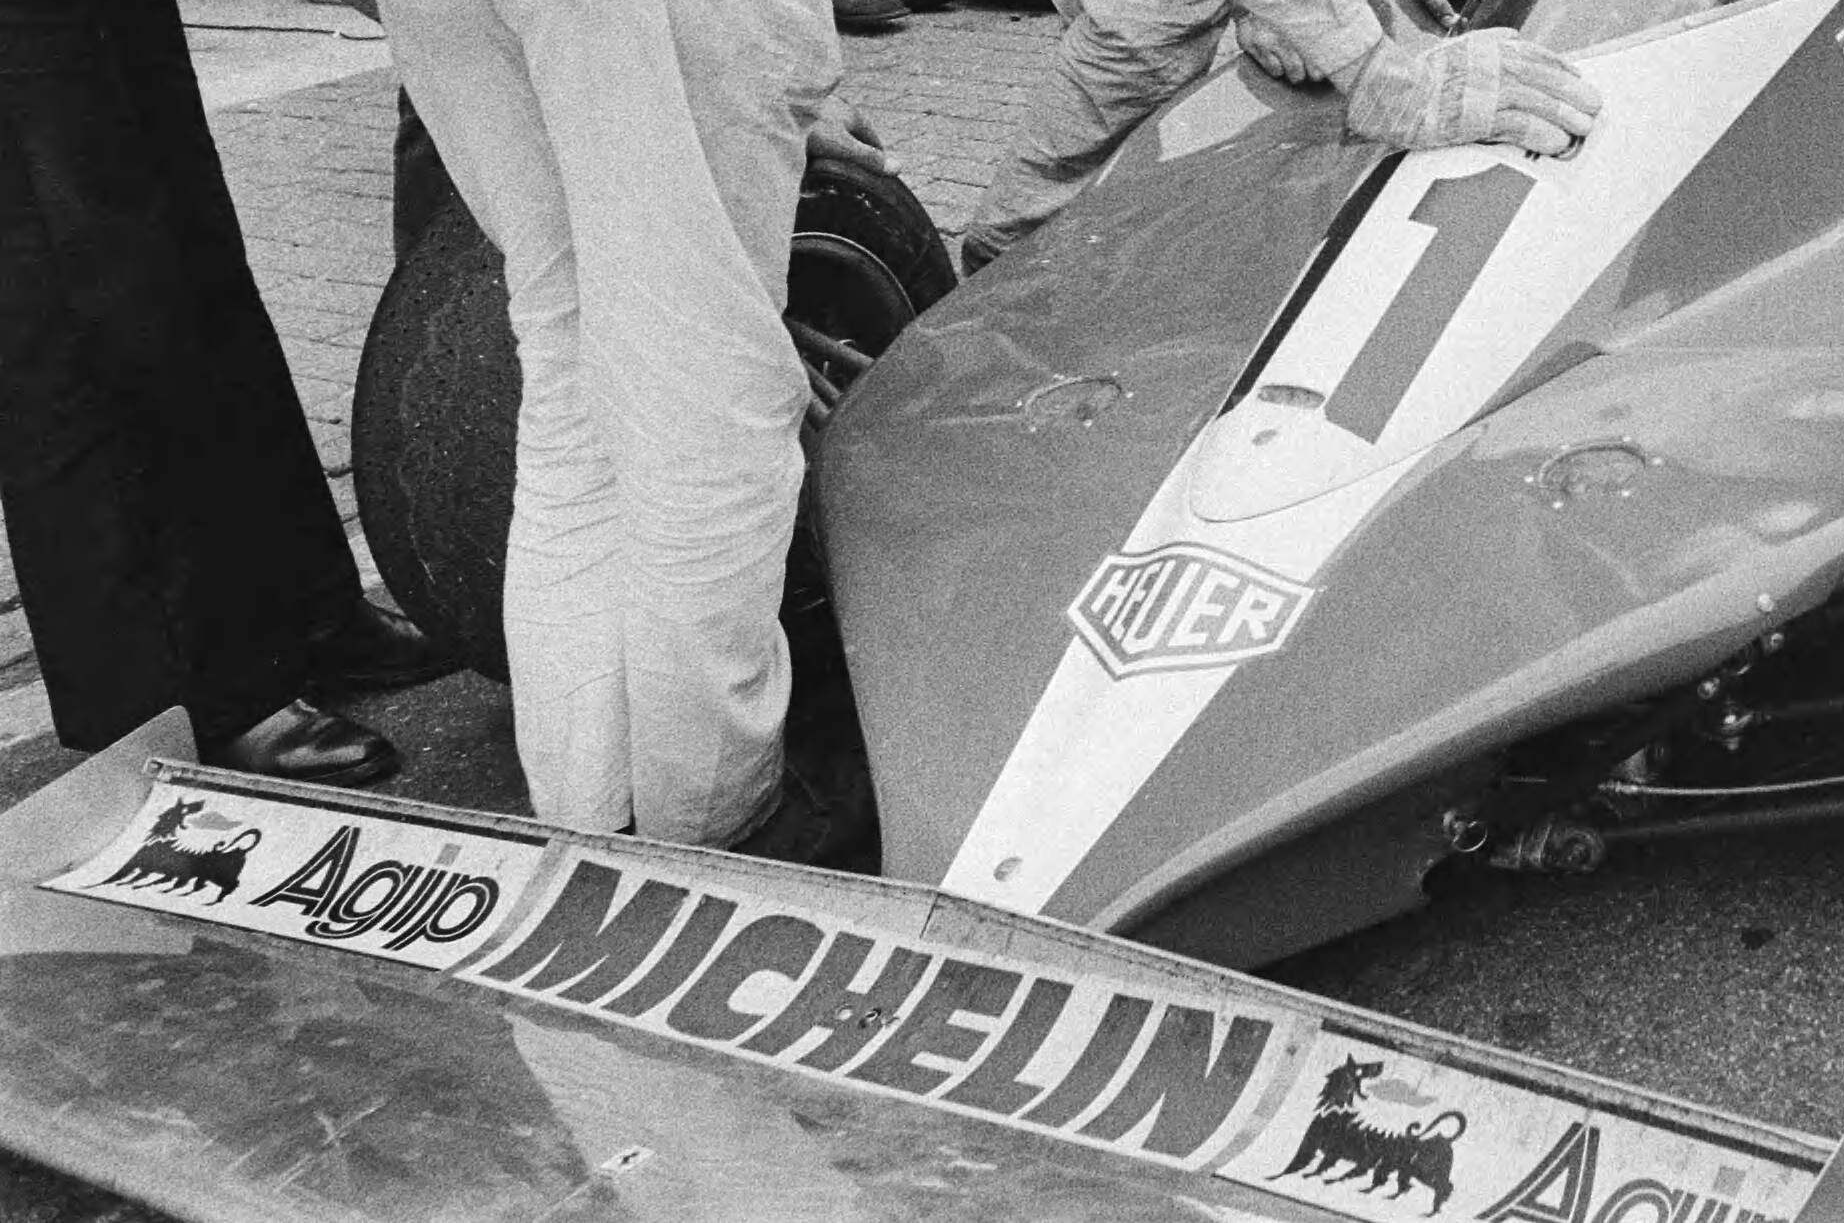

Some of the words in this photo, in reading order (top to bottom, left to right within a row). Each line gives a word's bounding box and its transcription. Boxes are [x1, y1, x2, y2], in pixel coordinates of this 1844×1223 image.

[1324, 163, 1538, 445] 1
[1091, 559, 1287, 655] HEUER
[249, 825, 501, 952] Agip
[480, 860, 1274, 1160] MICHELIN
